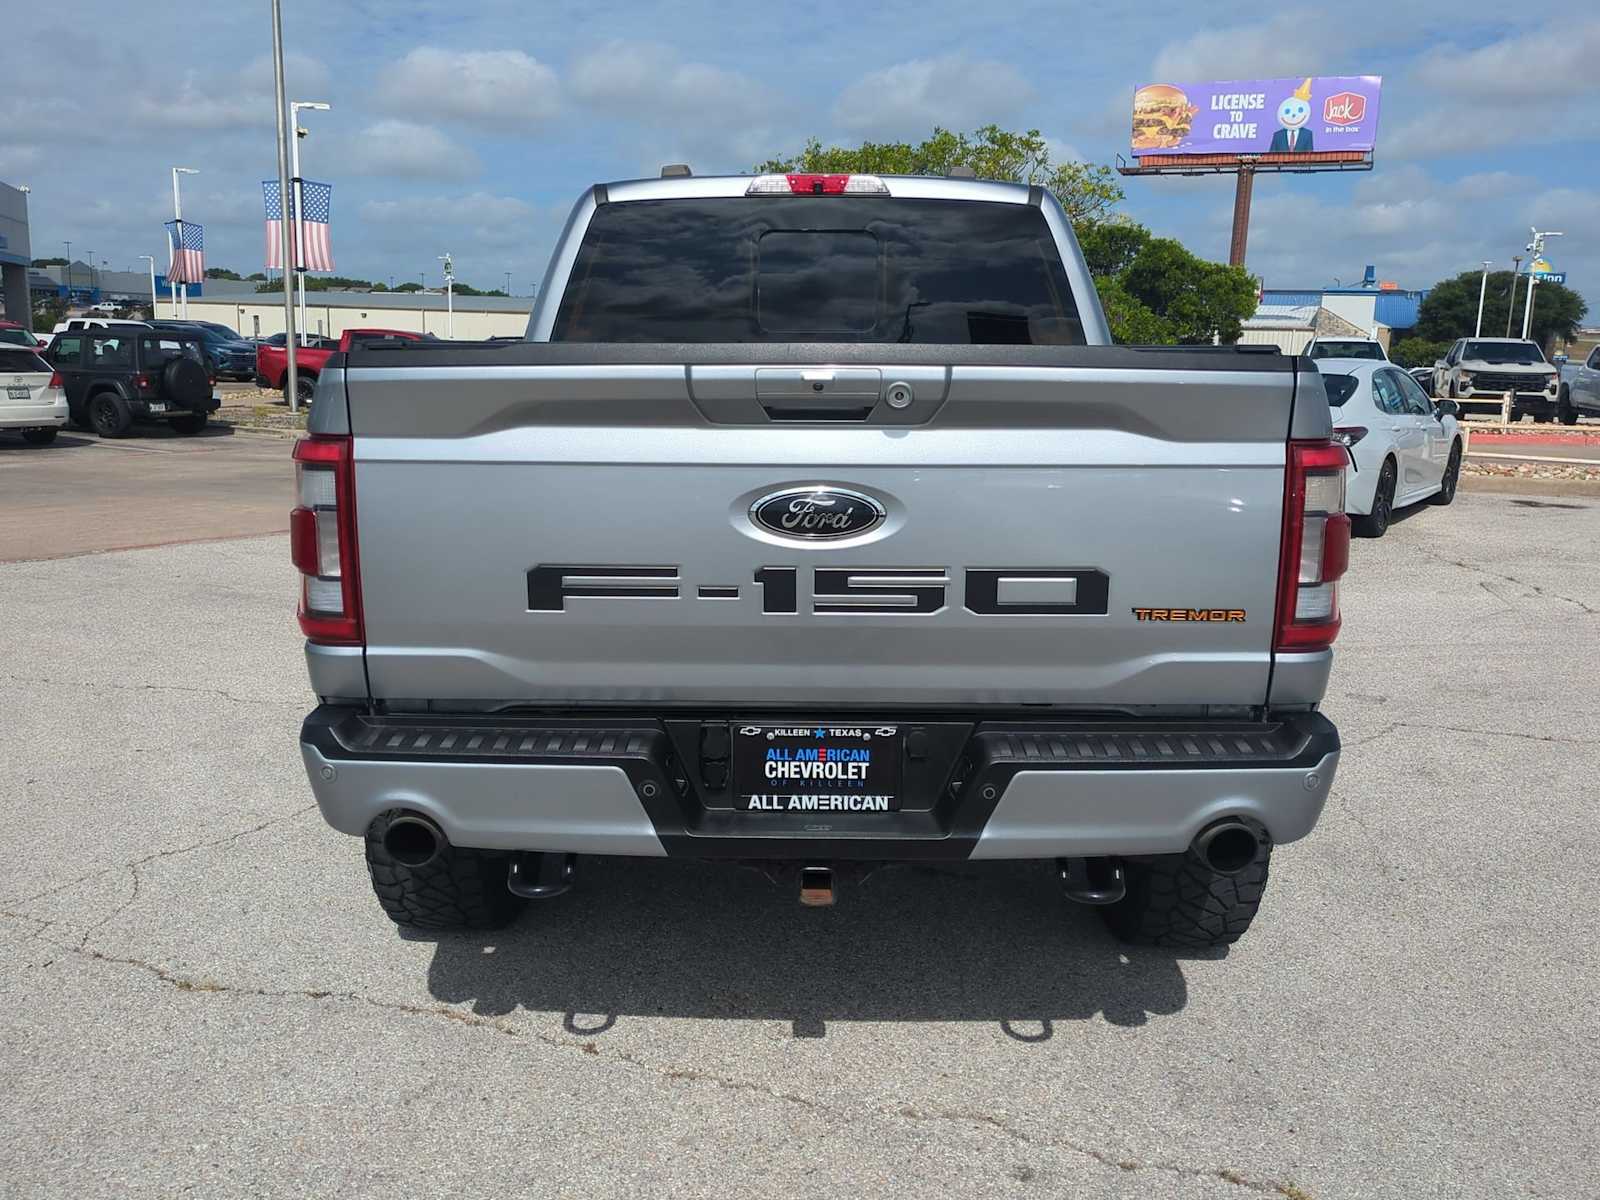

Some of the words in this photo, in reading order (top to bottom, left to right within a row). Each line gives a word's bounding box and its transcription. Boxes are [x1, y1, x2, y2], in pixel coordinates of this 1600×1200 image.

[1211, 94, 1264, 110] LICENSE
[1325, 95, 1362, 120] Jack
[1230, 111, 1243, 122] TO
[1213, 123, 1257, 139] CRAVE
[781, 497, 854, 529] Ford
[526, 564, 1112, 617] F-150
[1131, 608, 1247, 622] TREMOR
[774, 728, 811, 737] KILLEEN
[829, 728, 862, 737] TEXAS
[766, 748, 793, 761] ALL
[795, 747, 870, 762] AMERICAN
[764, 761, 870, 780] CHEVROLET
[771, 779, 788, 787] OF
[800, 779, 864, 788] KILLEEN
[748, 795, 784, 810] ALL
[788, 795, 889, 811] AMERICAN
